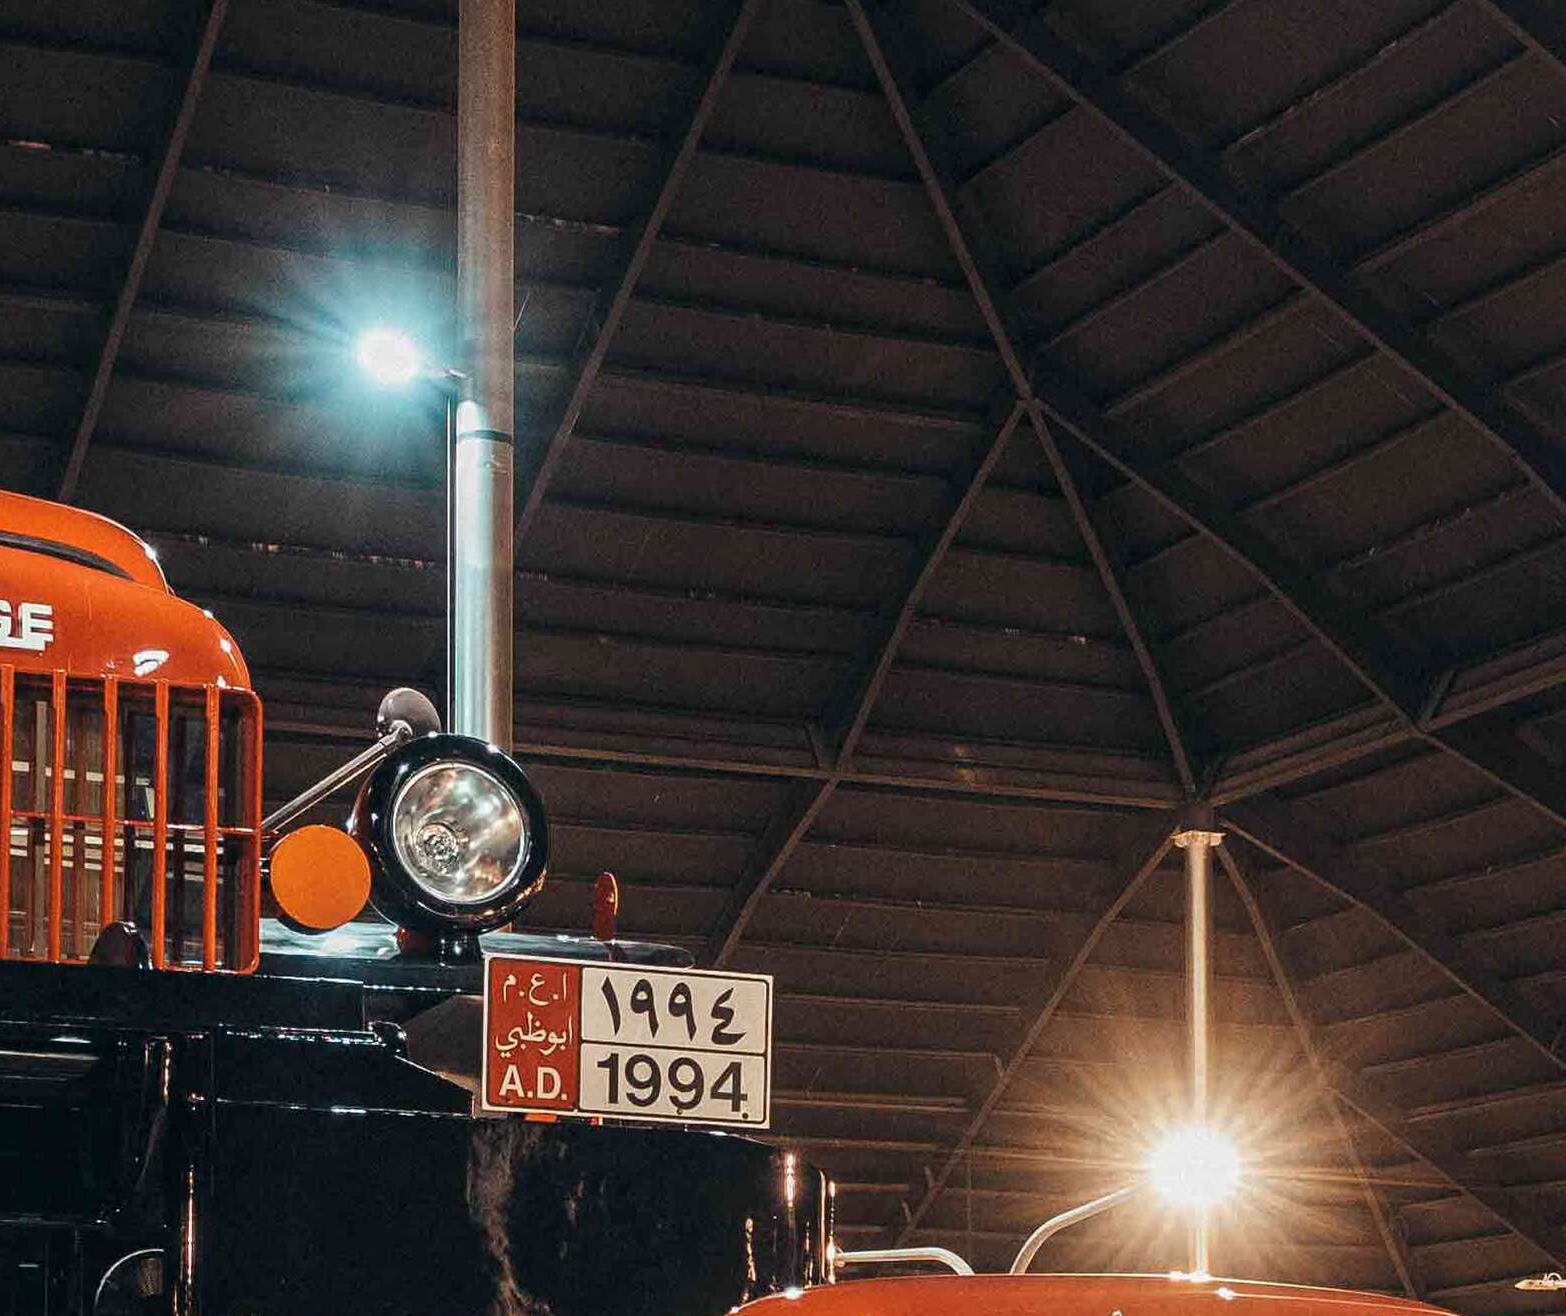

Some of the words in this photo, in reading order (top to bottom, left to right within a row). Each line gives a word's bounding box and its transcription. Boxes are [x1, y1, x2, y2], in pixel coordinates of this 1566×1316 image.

[495, 1011, 573, 1058] ابوظبي
[601, 975, 747, 1046] ١٩٩٤
[498, 1064, 568, 1101] A.D.
[597, 1053, 748, 1113] 1994
